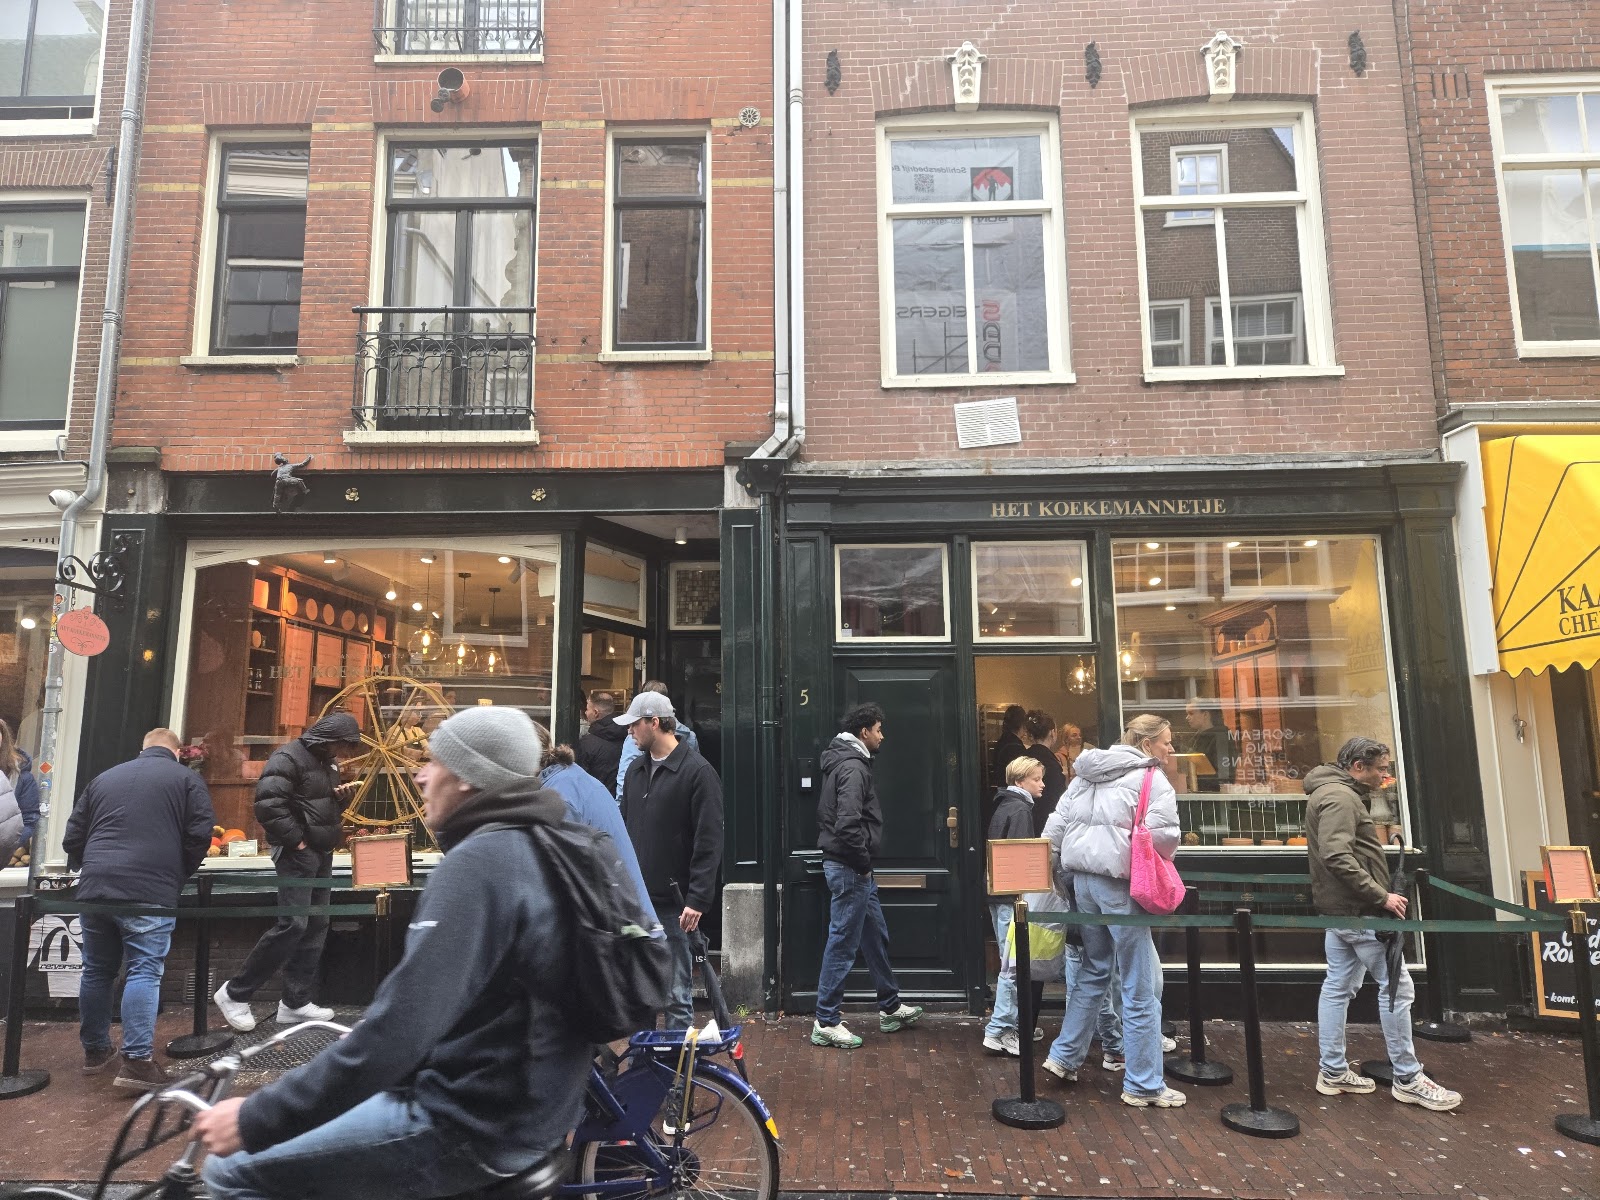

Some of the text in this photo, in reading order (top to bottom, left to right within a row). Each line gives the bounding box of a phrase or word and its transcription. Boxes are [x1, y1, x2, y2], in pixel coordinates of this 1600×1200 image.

[990, 498, 1227, 518] HET KOEKEMANNETJE
[1557, 582, 1600, 615] KA
[1559, 611, 1600, 636] CHE
[799, 688, 809, 706] 5
[1550, 991, 1576, 1004] komt
